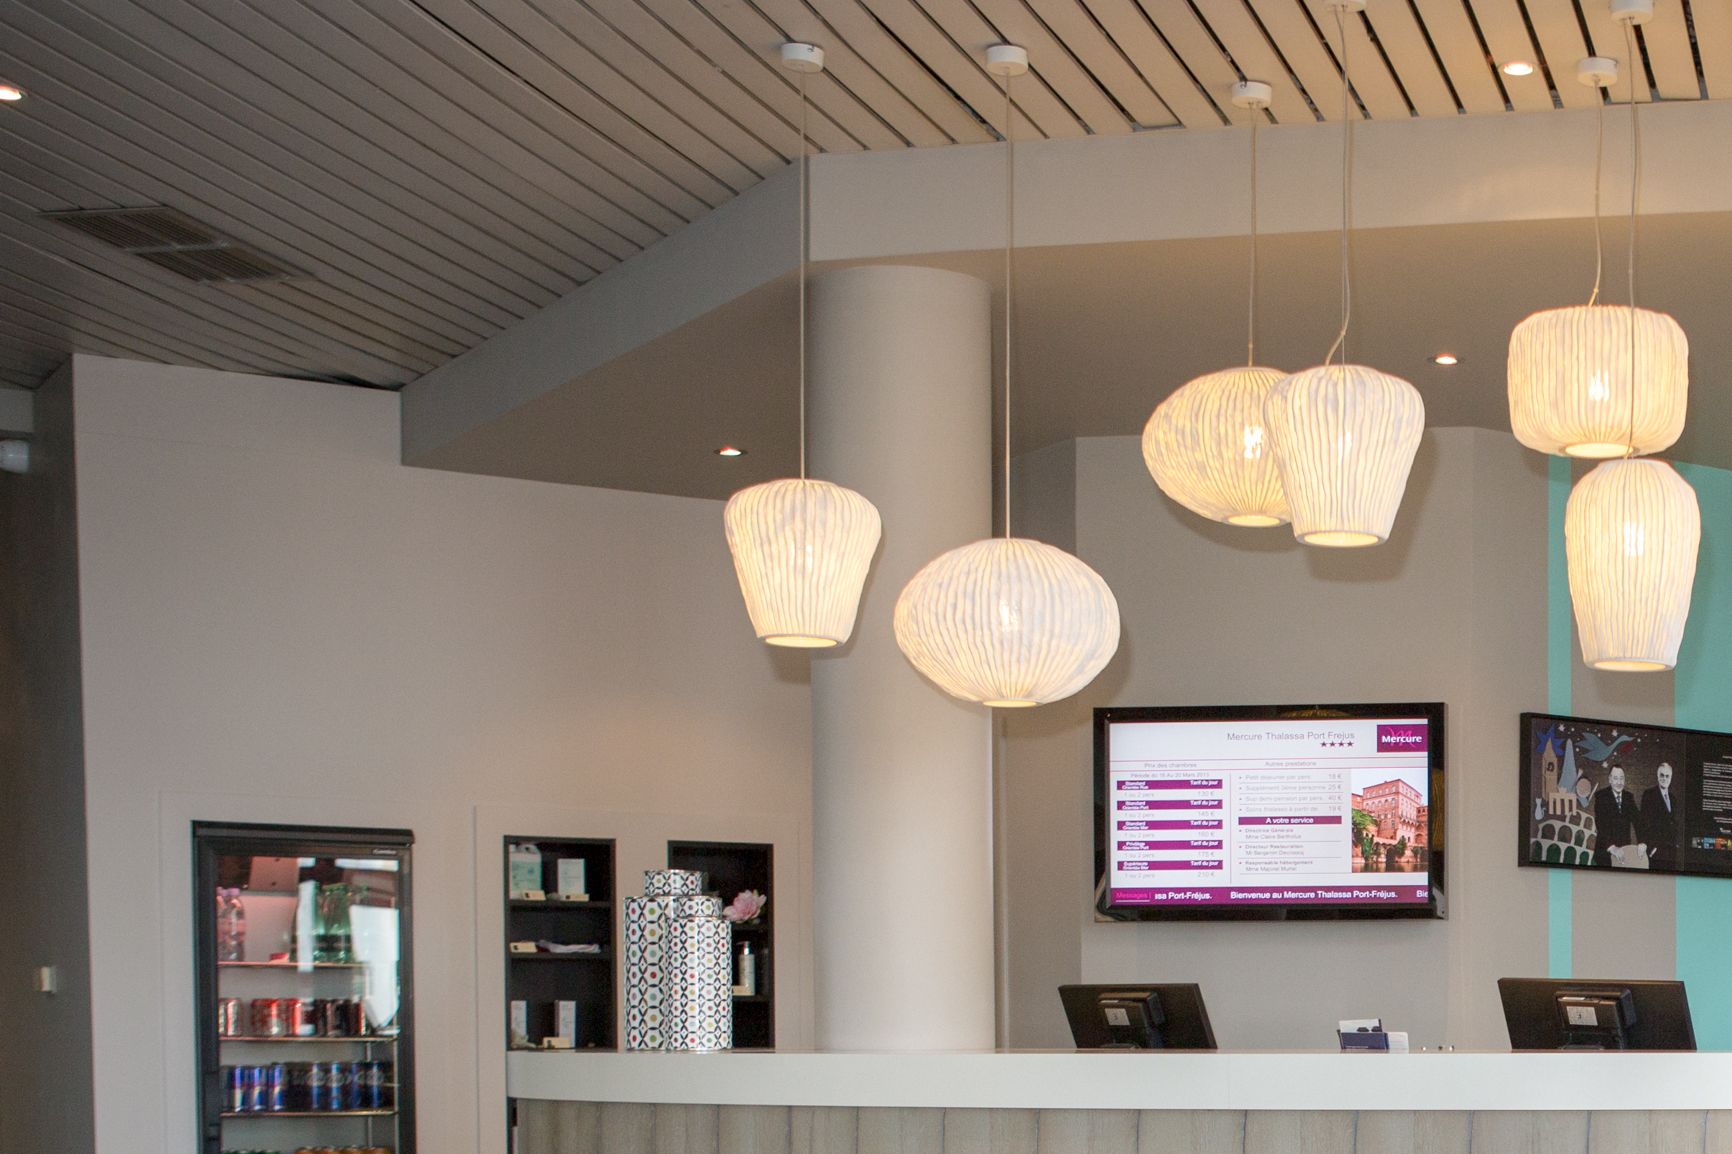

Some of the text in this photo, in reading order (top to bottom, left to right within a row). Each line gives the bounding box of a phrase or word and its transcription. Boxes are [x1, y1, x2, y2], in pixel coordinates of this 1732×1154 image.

[1227, 732, 1262, 741] Mercure
[1265, 731, 1305, 740] Thalassa
[1307, 731, 1326, 740] Port
[1381, 735, 1423, 744] Mercure
[1290, 816, 1314, 824] service
[1167, 891, 1213, 901] Port-Fréjus.
[1230, 891, 1271, 899] Bienvenue
[1282, 891, 1316, 899] Mercure
[1316, 890, 1351, 898] Thalassa
[1352, 890, 1398, 899] Port-Fréjus.
